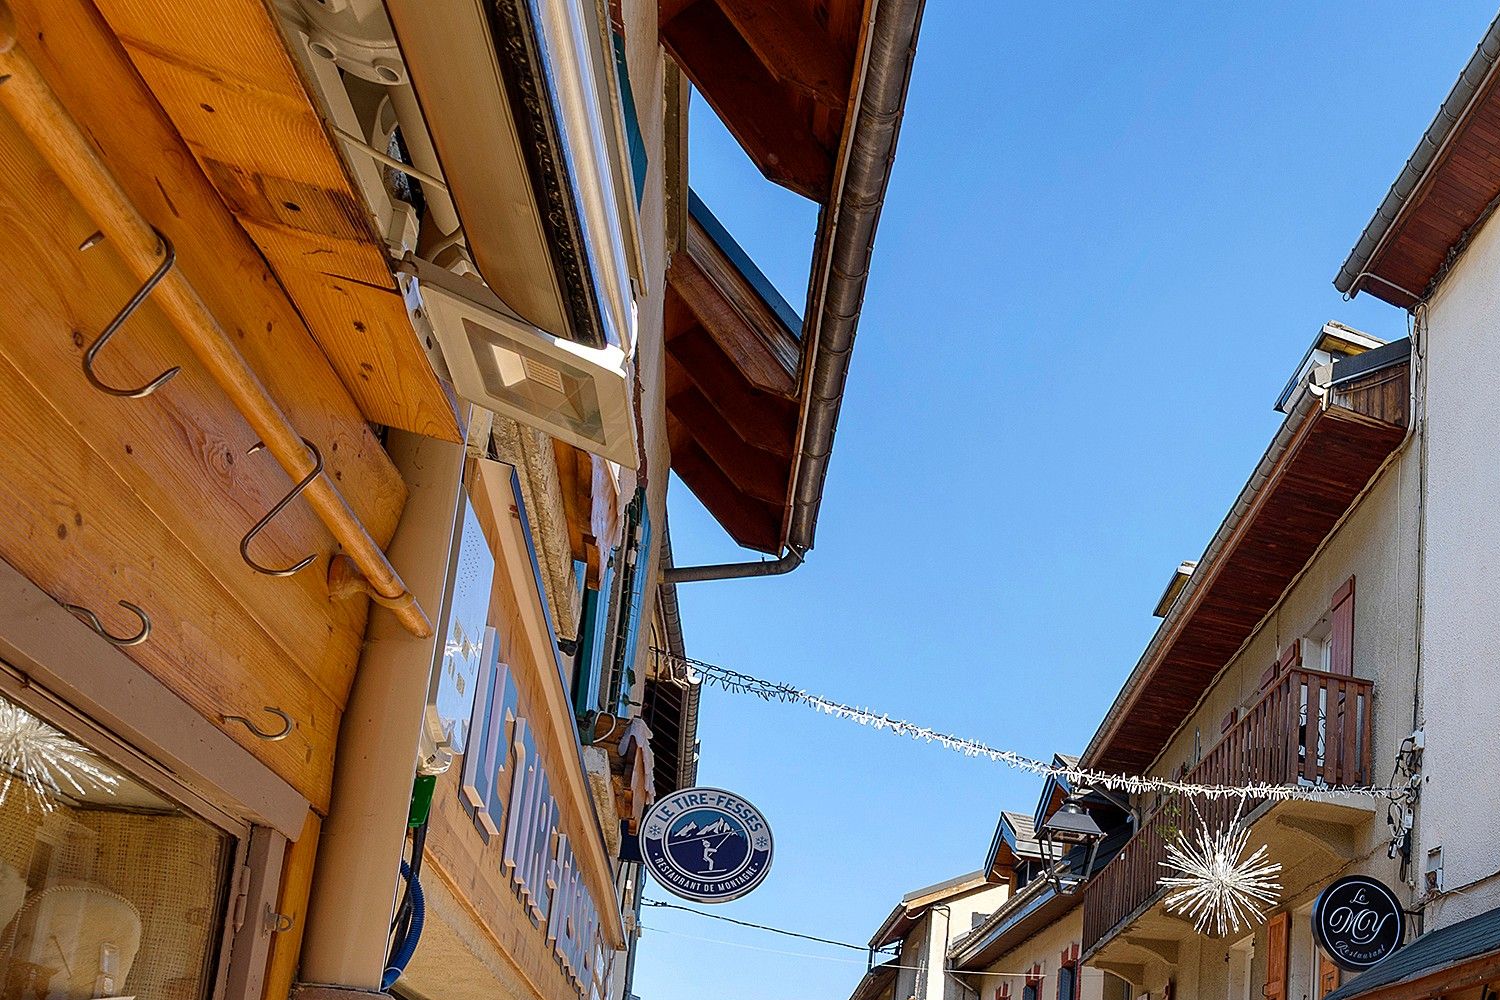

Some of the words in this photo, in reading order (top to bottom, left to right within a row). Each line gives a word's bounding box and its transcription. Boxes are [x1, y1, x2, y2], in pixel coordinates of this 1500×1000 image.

[655, 806, 675, 823] LE
[672, 793, 763, 832] TIRE-FESSES
[655, 858, 701, 891] RESTAURANT
[704, 884, 715, 892] DE
[718, 866, 758, 892] MONTAGNE
[1349, 887, 1370, 905] Le
[1335, 940, 1386, 959] Restaurant
